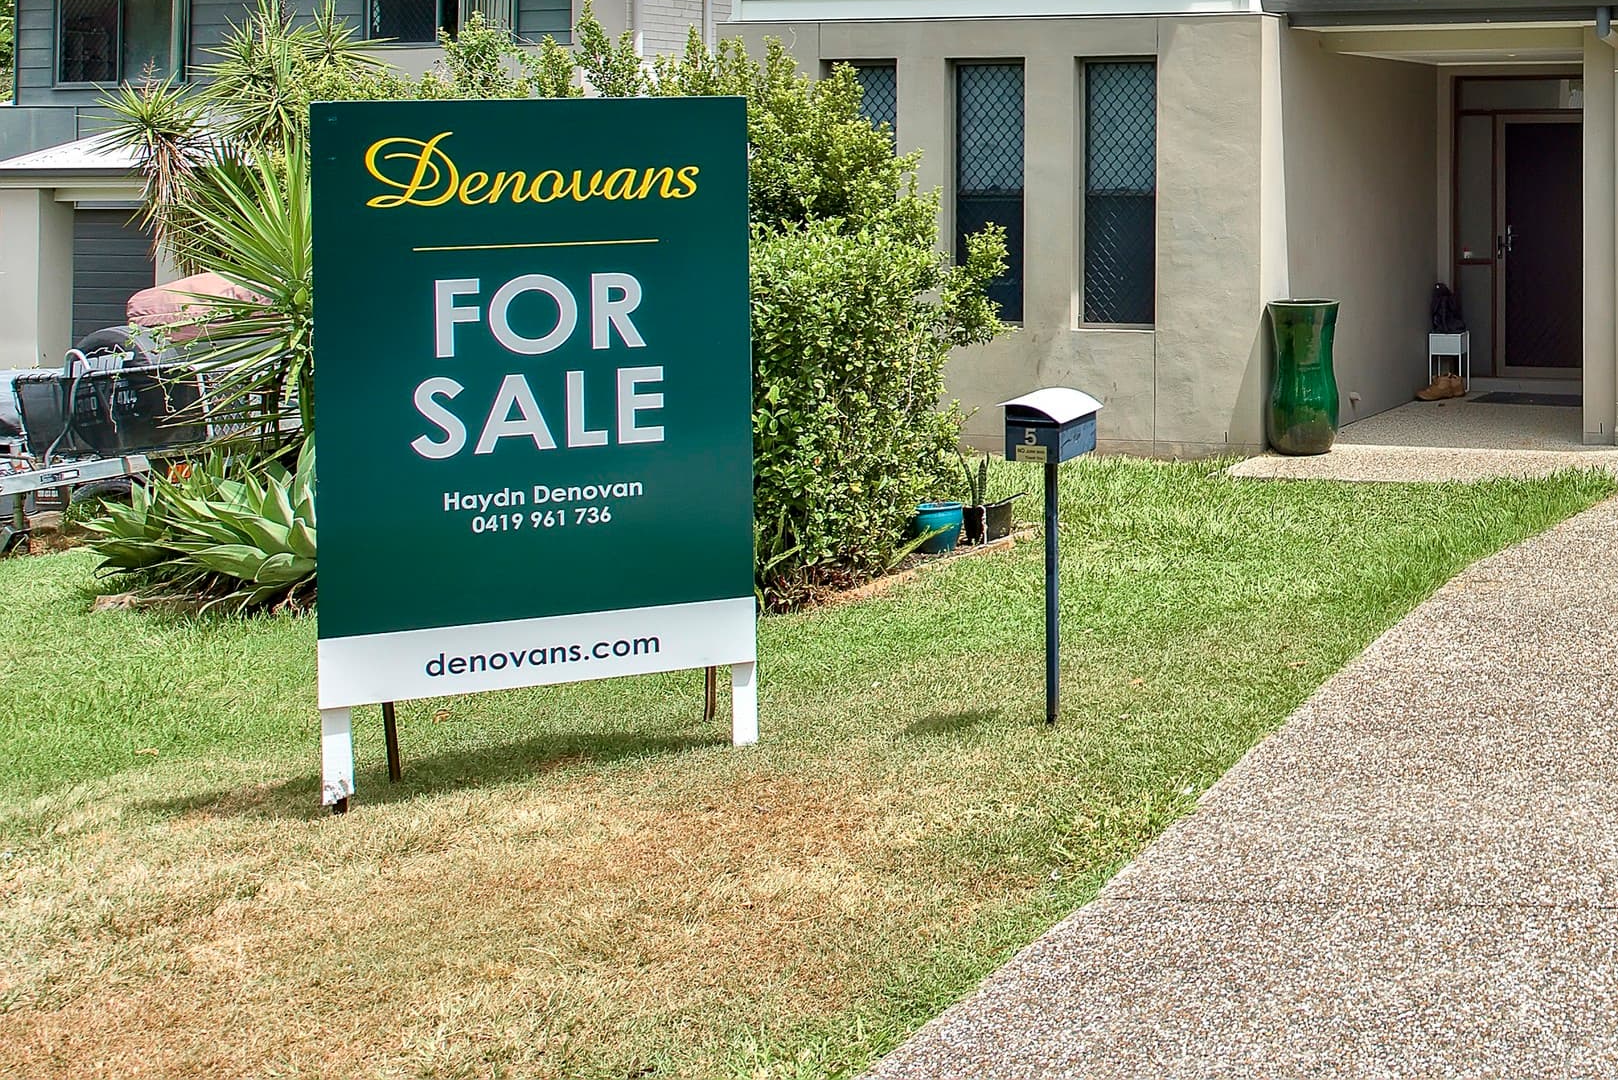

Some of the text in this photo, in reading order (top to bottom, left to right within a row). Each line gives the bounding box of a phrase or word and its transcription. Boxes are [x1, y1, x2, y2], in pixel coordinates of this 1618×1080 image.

[365, 131, 700, 208] Denovans
[434, 272, 647, 358] FOR
[411, 366, 664, 459] SALE
[1024, 427, 1037, 445] 5
[443, 481, 643, 512] Haydn Denovan
[472, 506, 612, 533] 0419 961 736
[425, 636, 660, 677] denovans.com
